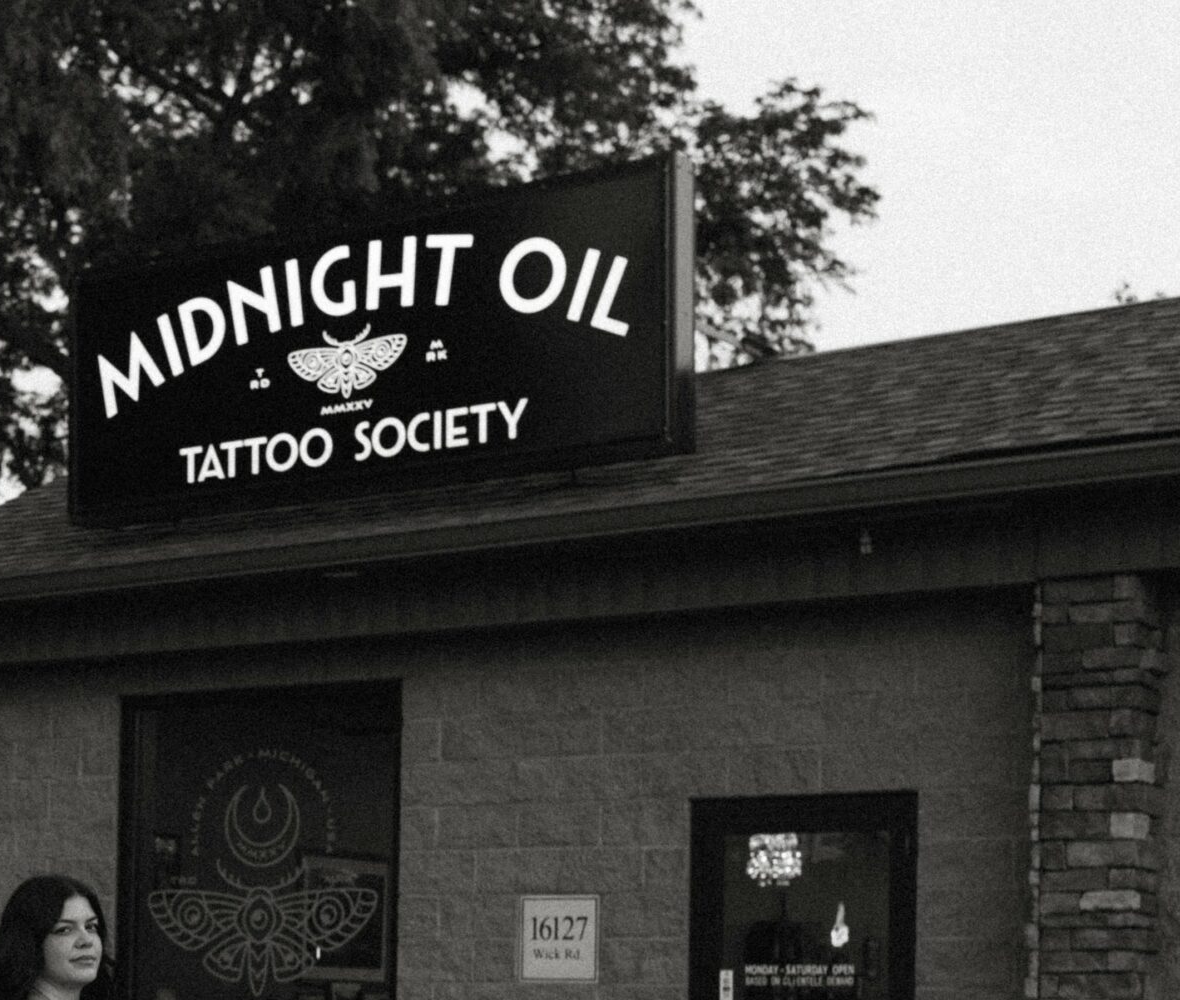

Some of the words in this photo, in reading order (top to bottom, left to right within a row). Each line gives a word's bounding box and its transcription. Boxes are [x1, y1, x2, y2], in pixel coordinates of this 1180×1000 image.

[97, 233, 474, 419] MIDNIGHT
[499, 236, 630, 337] OIL
[320, 398, 374, 416] MMXXV
[179, 427, 333, 484] TATTOO
[354, 397, 529, 462] SOCIETY
[530, 915, 589, 941] 16127
[744, 963, 779, 975] MONDAY
[785, 963, 828, 975] SATURDAY
[831, 963, 855, 975] OPEN
